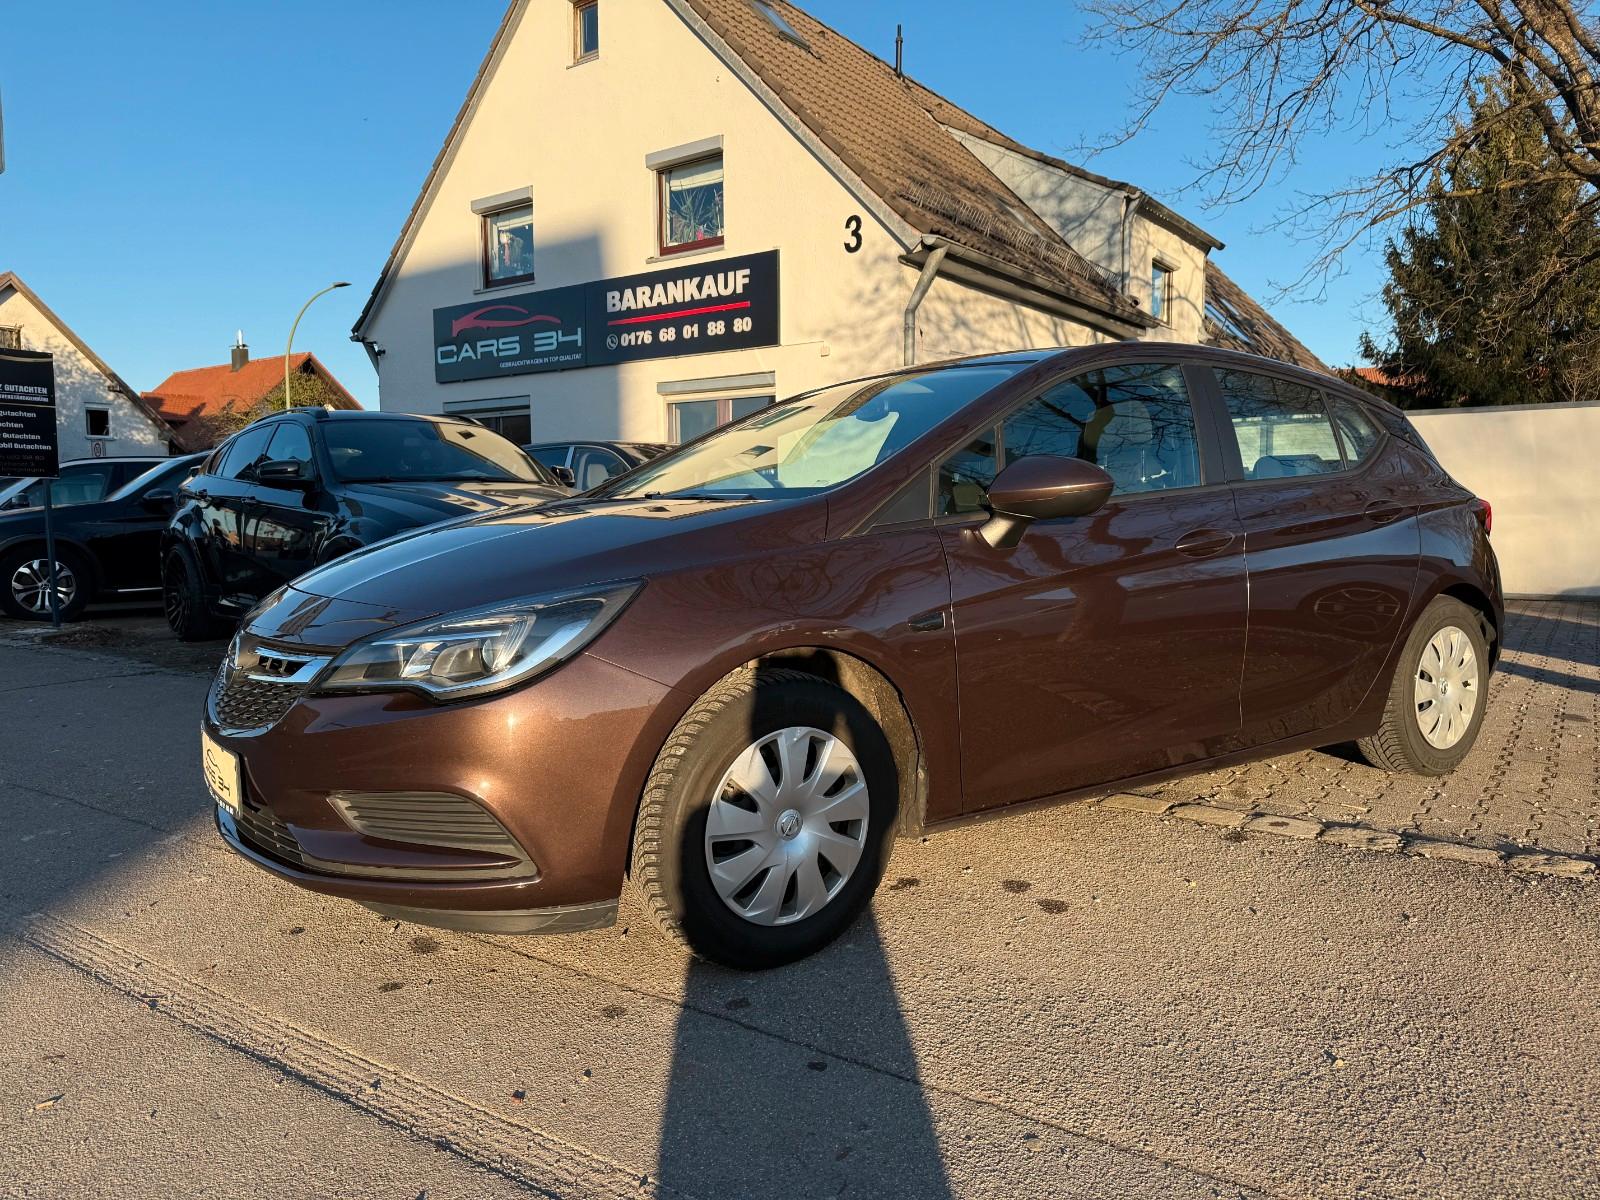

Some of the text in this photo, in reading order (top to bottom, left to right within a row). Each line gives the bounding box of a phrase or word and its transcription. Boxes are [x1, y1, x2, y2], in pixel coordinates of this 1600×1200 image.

[843, 214, 863, 254] 3
[606, 268, 751, 313] BARANKAUF
[437, 327, 582, 364] CARS 34
[620, 316, 753, 347] 0176 68 01 88 80
[4, 384, 48, 394] GUTACHTEN
[2, 432, 41, 440] Gutachten
[14, 443, 52, 451] Gutachten
